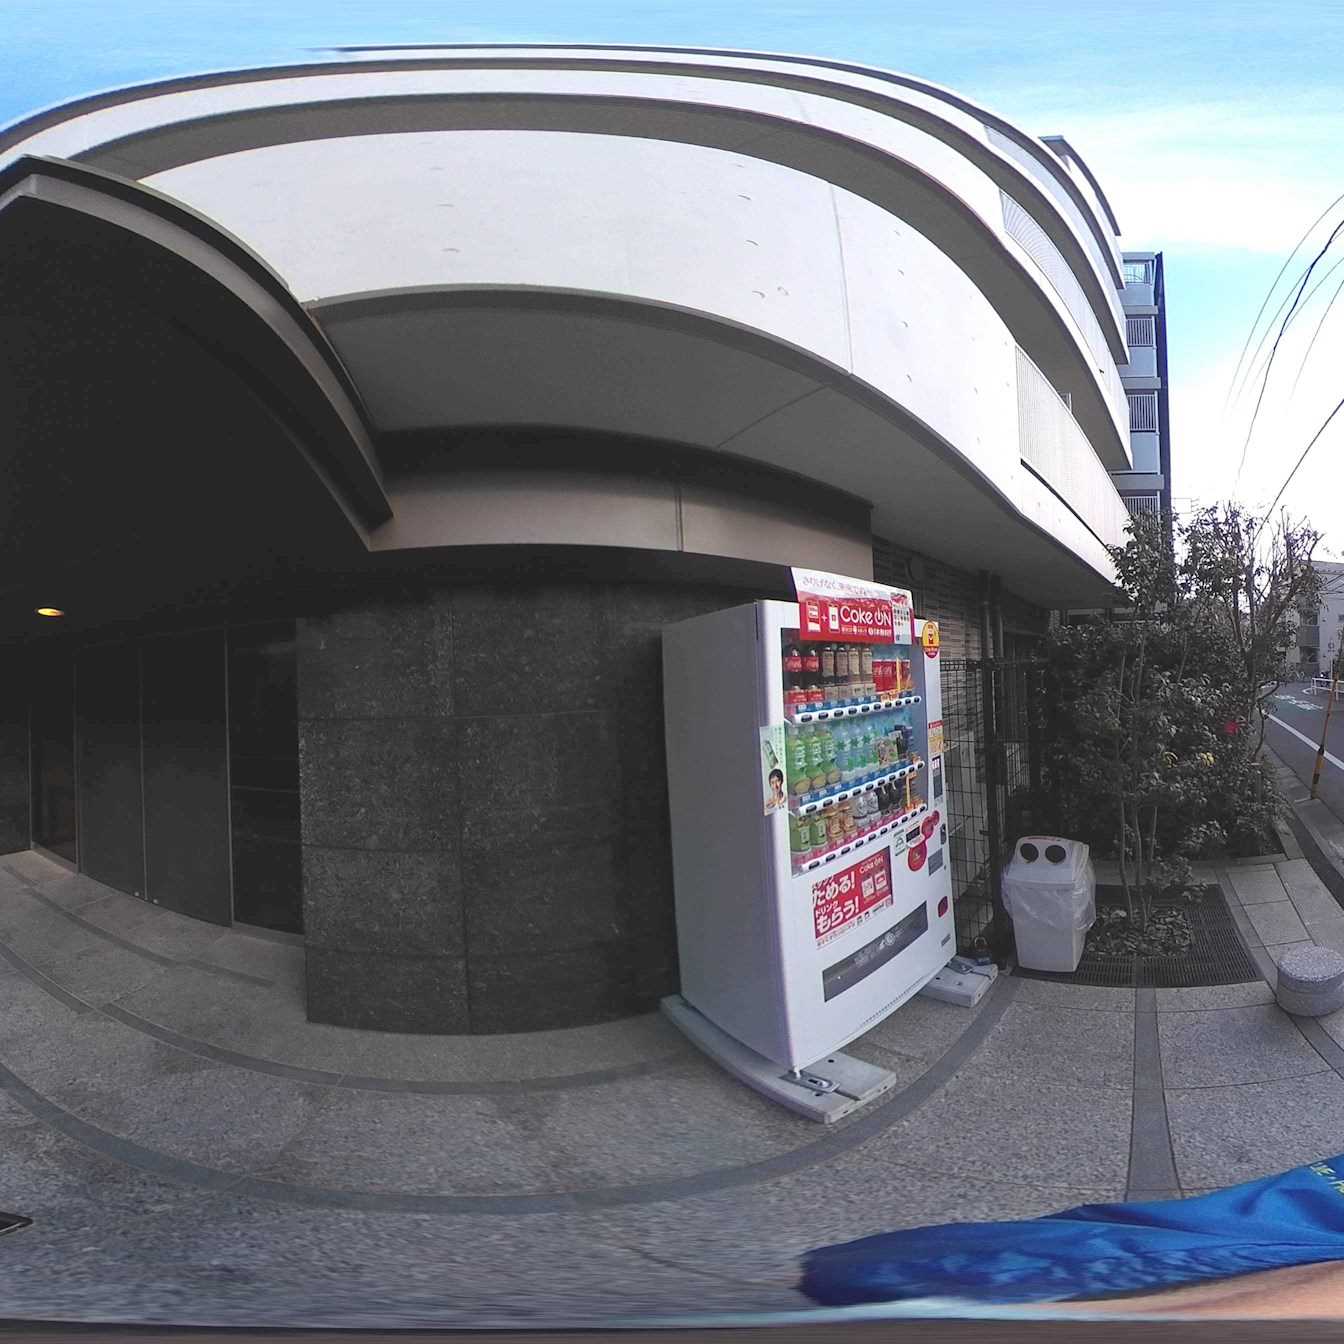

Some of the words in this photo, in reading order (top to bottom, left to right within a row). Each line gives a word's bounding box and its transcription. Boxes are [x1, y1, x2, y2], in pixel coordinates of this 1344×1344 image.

[840, 606, 873, 625] Coke
[874, 608, 892, 626] ON
[817, 895, 860, 933] もらう!
